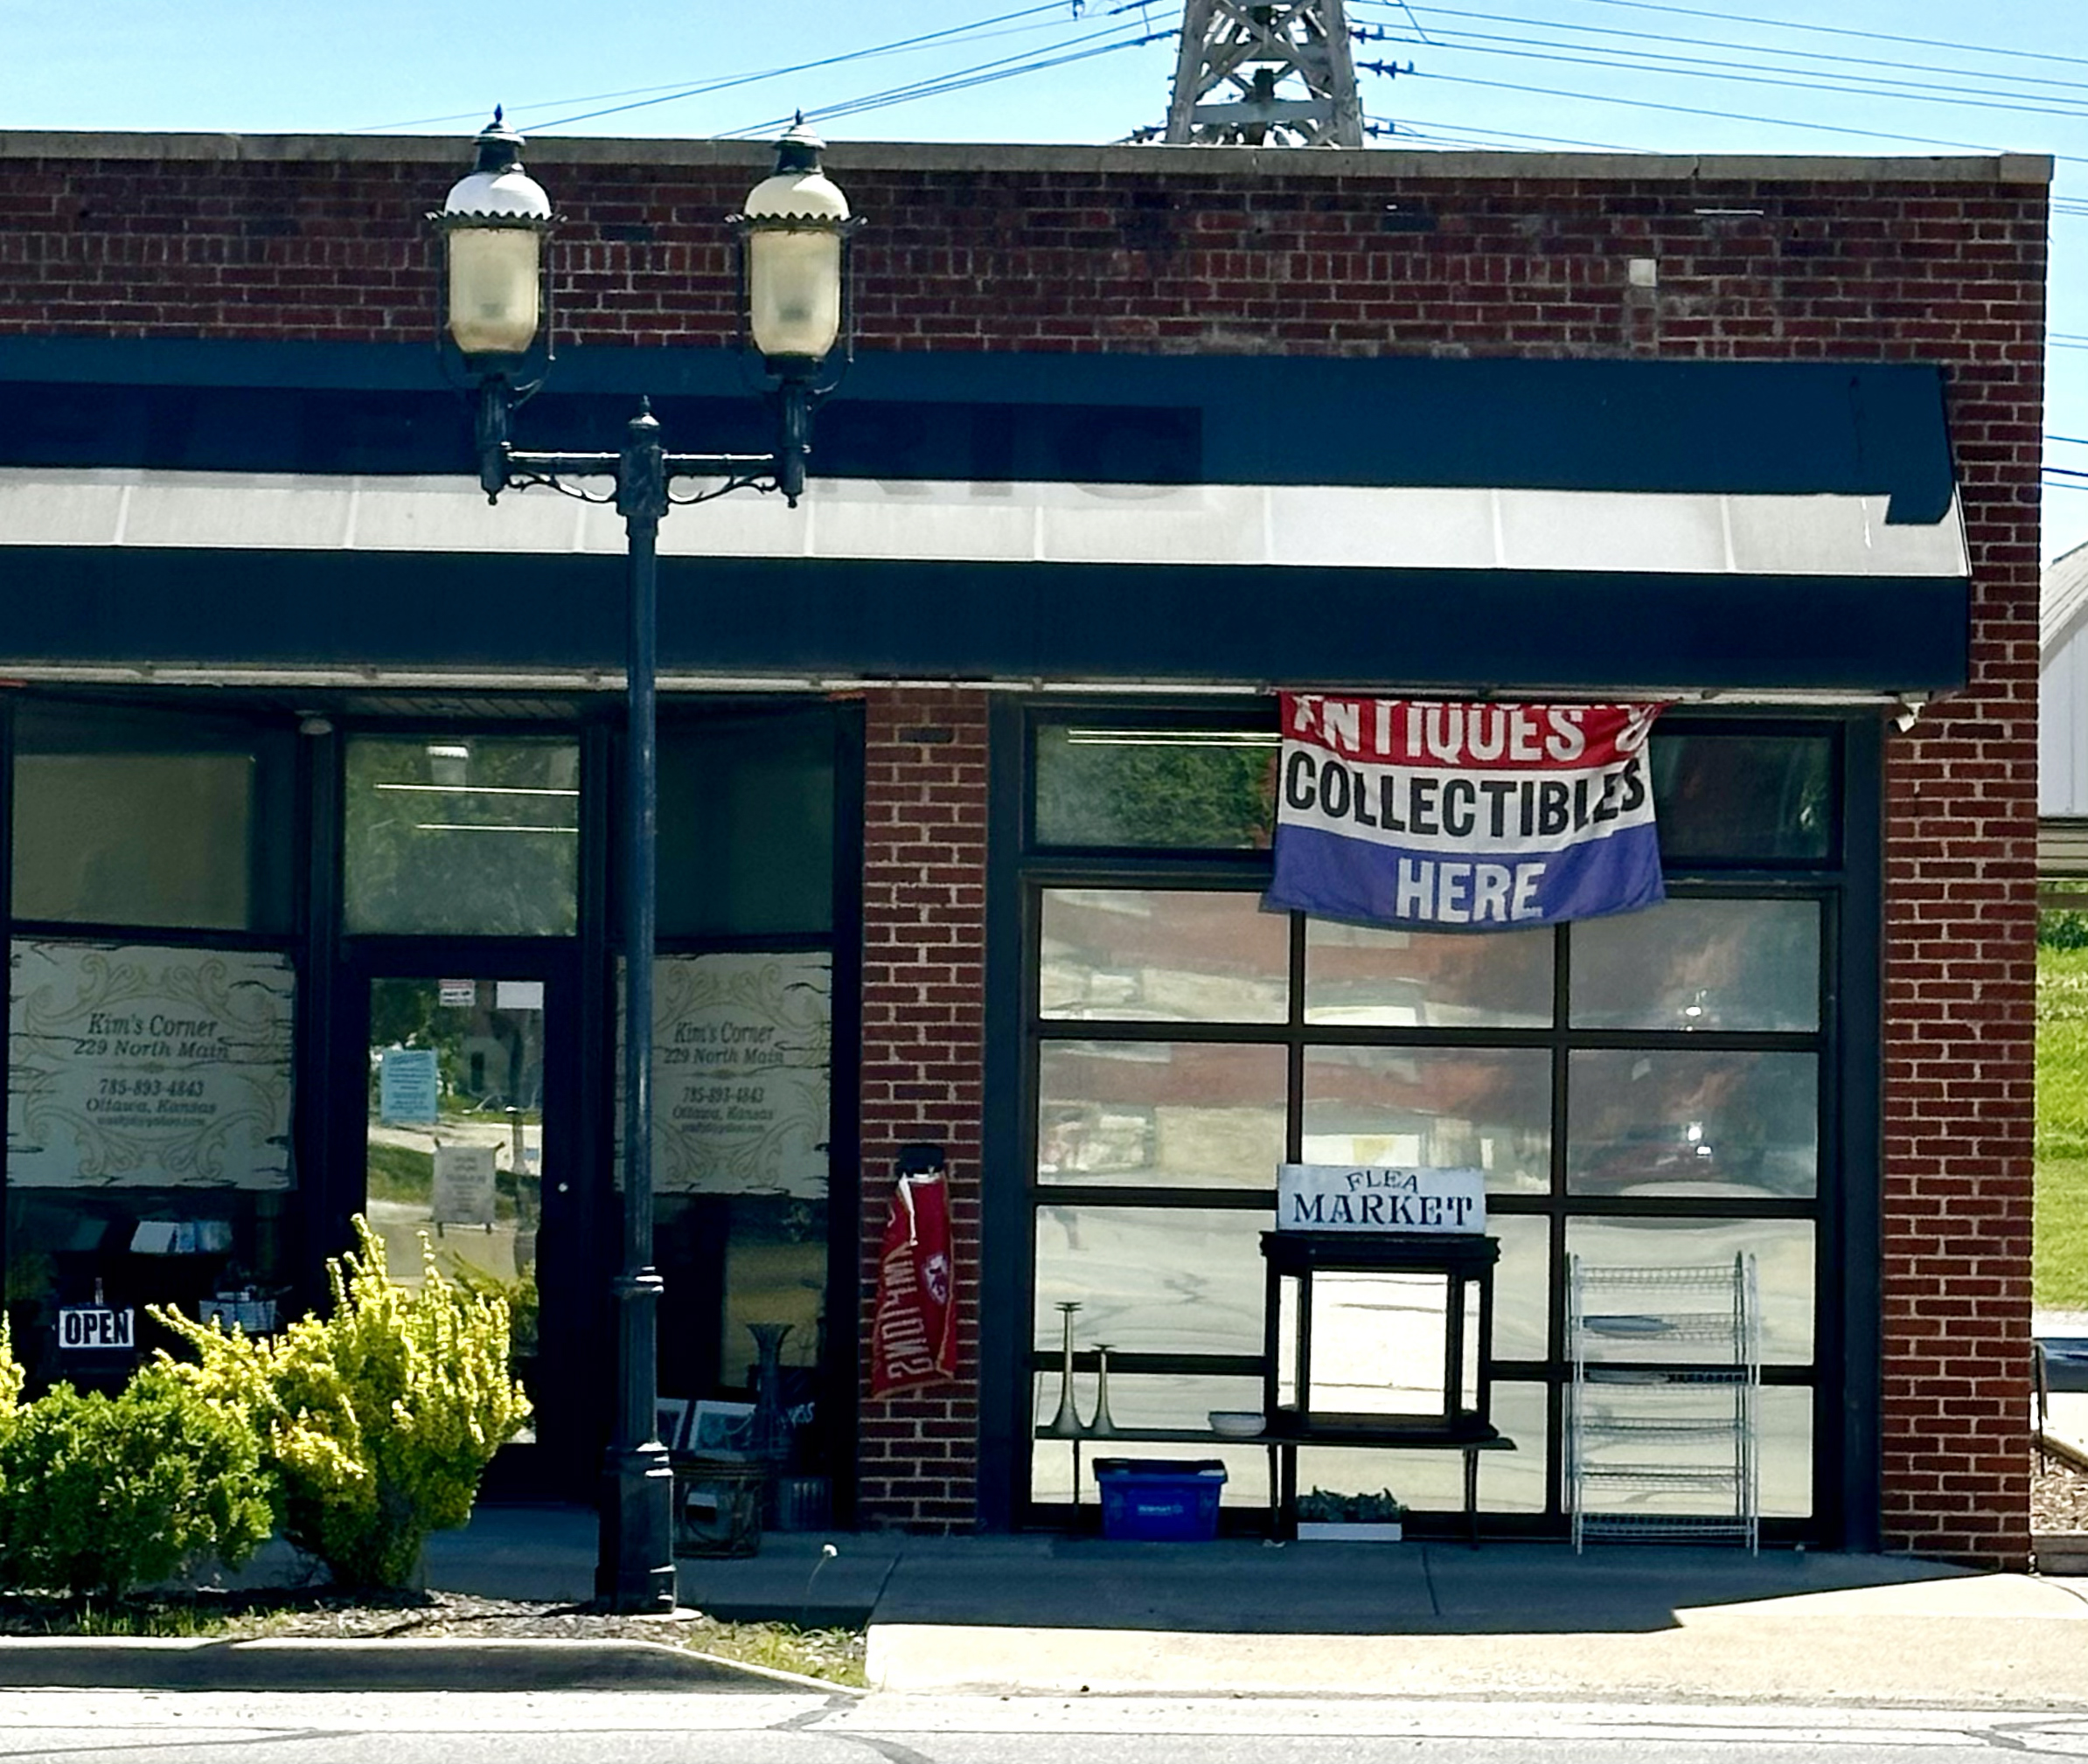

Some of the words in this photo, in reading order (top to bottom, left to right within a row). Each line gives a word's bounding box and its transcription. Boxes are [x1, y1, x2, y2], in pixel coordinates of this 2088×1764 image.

[1286, 750, 1646, 837] COLLECTIBLES
[1395, 858, 1547, 923] HERE
[88, 1013, 143, 1035] Kim's
[150, 1015, 218, 1038] Corner
[674, 1021, 717, 1044] Kim's
[721, 1021, 775, 1044] Corner
[74, 1038, 108, 1056] 229
[115, 1039, 171, 1057] North
[177, 1041, 229, 1059] Main
[693, 1047, 737, 1064] North
[1345, 1170, 1418, 1194] FLEA
[1292, 1193, 1472, 1226] MARKET
[64, 1312, 129, 1345] OPEN
